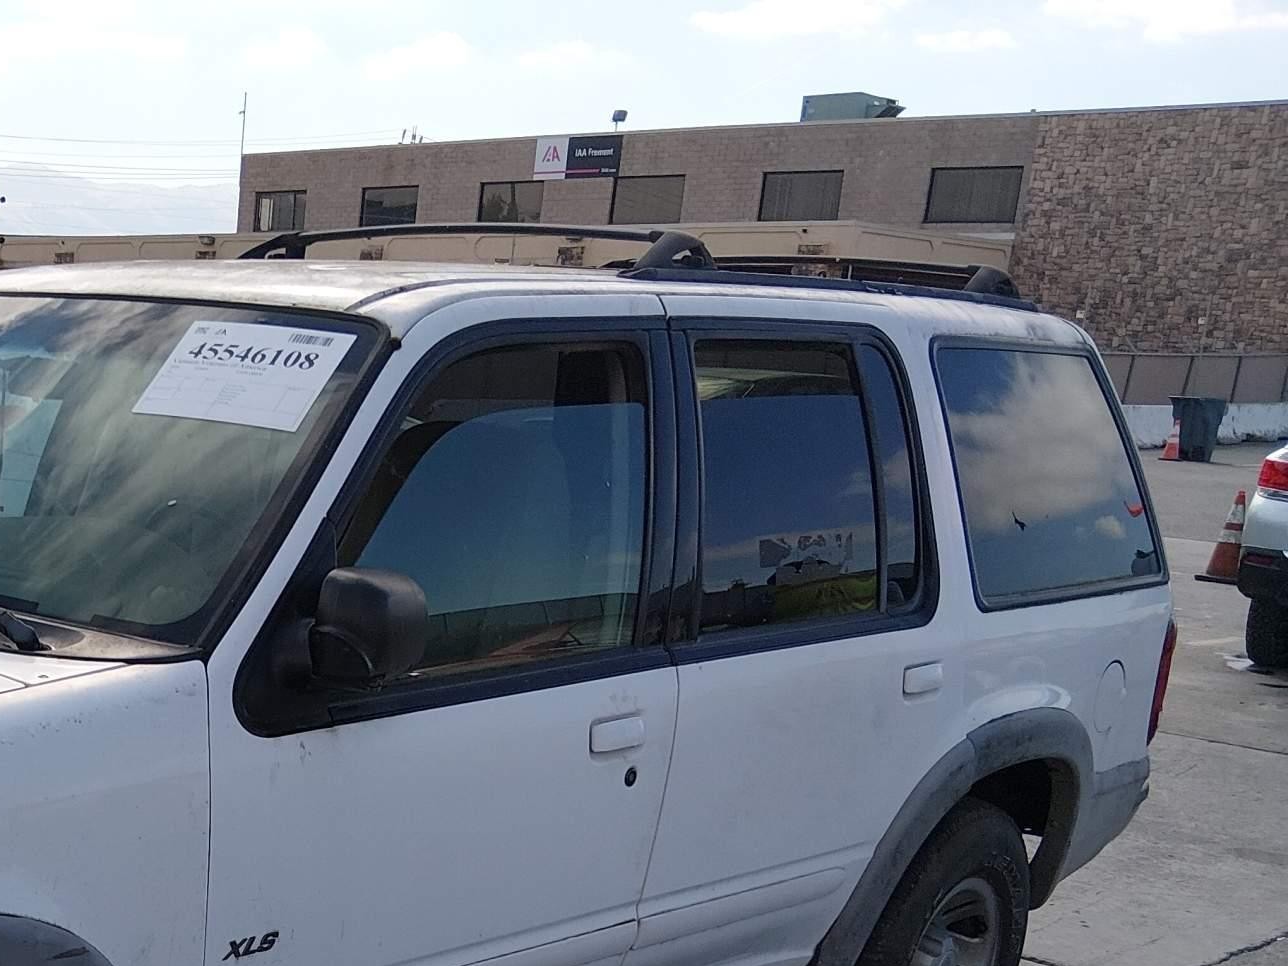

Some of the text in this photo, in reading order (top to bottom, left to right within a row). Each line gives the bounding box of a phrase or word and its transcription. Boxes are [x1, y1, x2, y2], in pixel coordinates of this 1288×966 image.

[575, 149, 587, 157] IAA
[188, 342, 320, 371] 45546108
[222, 931, 279, 961] XLS
